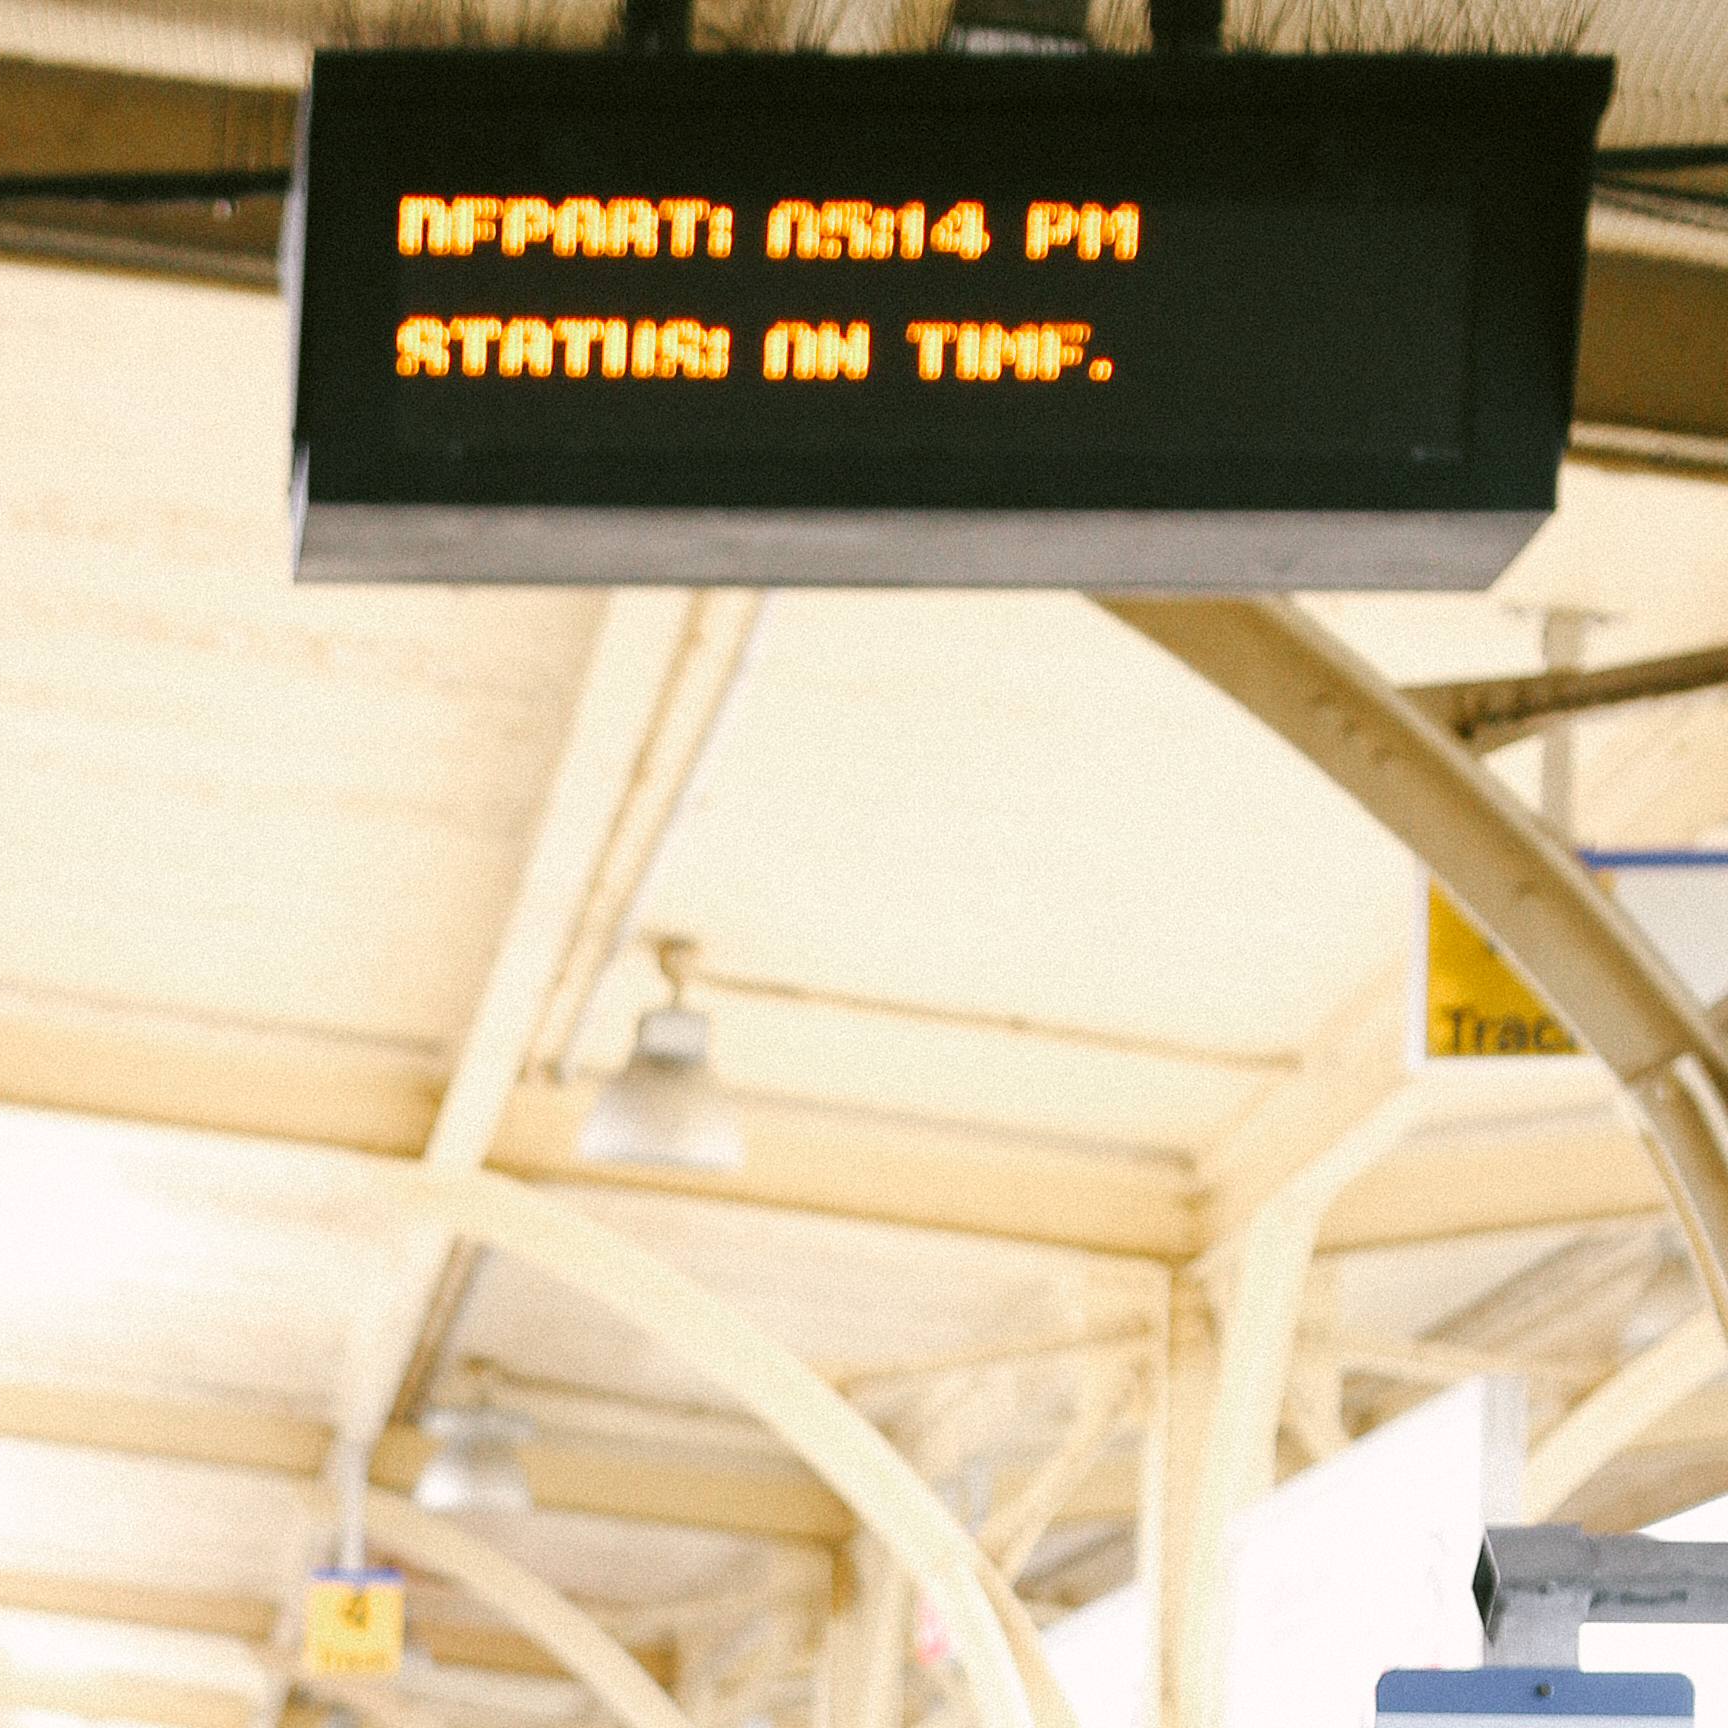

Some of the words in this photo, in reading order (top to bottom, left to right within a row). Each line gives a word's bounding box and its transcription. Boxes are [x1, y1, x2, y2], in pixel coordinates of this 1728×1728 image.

[1026, 201, 1139, 260] PM
[763, 321, 870, 380] ON
[1439, 1003, 1578, 1050] Trac
